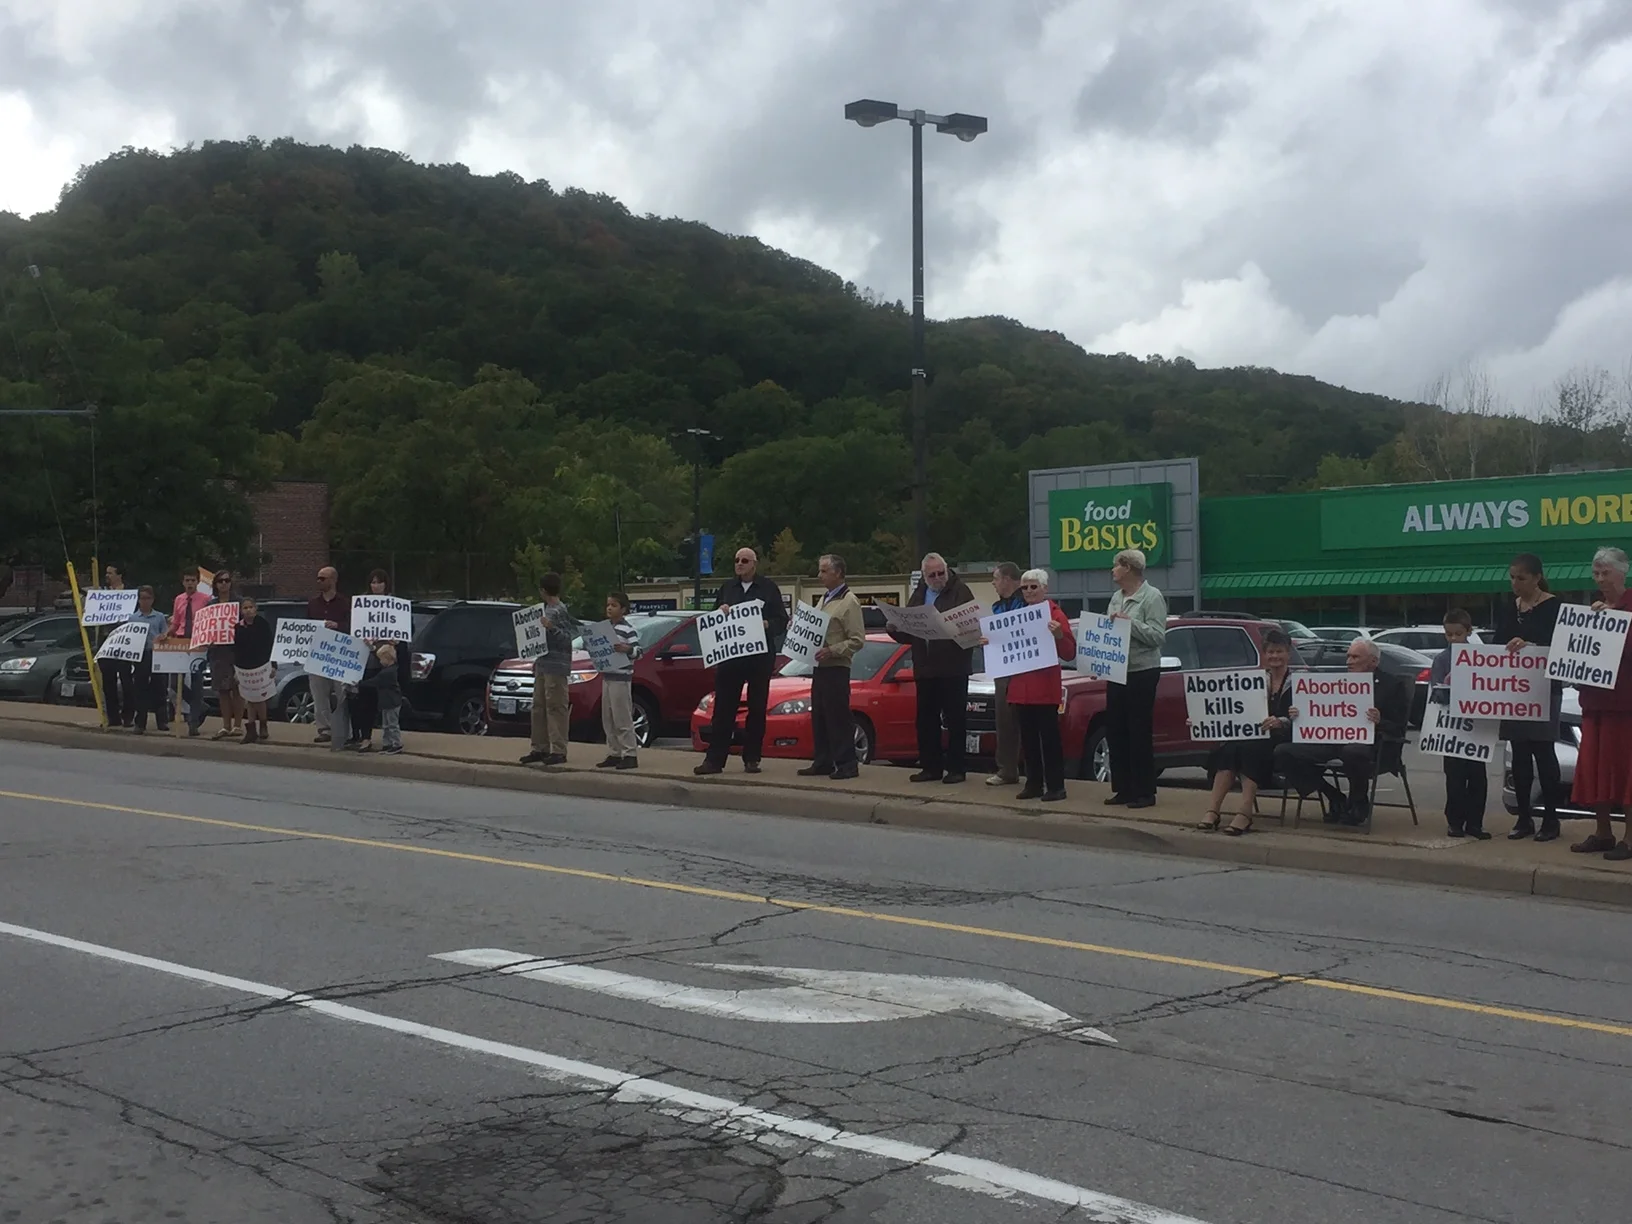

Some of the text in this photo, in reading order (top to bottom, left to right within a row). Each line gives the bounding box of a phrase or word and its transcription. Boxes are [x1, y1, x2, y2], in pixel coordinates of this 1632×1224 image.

[1084, 500, 1132, 522] food
[1402, 494, 1632, 533] ALWAYS MORE
[88, 592, 137, 601] Abortion
[353, 597, 411, 612] Abortion
[99, 603, 122, 611] kills
[196, 603, 239, 623] ABORTION
[944, 605, 980, 623] ABORTION
[194, 616, 237, 634] HURTS
[368, 611, 397, 624] kills
[698, 604, 761, 632] Abortion
[989, 609, 1043, 632] ADOPTION
[1098, 618, 1113, 630] Life
[1557, 606, 1628, 634] Abortion
[281, 621, 317, 634] Adoptio
[354, 627, 410, 640] children
[525, 625, 541, 640] kills
[714, 626, 746, 643] kills
[1010, 628, 1026, 639] THE
[276, 634, 313, 645] the lovi
[334, 633, 353, 645] Life
[1002, 637, 1038, 653] LOVING
[1085, 628, 1123, 648] the first
[1567, 633, 1601, 656] kills
[282, 647, 309, 659] optio
[320, 641, 360, 660] the first
[521, 642, 548, 659] childre
[706, 640, 765, 664] children
[1003, 649, 1040, 665] OPTION
[1078, 645, 1127, 665] inalienable
[1455, 649, 1547, 670] Abortion
[310, 649, 363, 671] inalienable
[321, 664, 346, 678] right
[1091, 661, 1112, 678] right
[1549, 660, 1613, 686] children
[1187, 674, 1264, 693] Abortion
[1296, 678, 1371, 695] Abortion
[1472, 672, 1531, 693] hurts
[1204, 697, 1244, 716] kills
[1309, 700, 1358, 718] hurts
[1458, 699, 1542, 717] women
[1299, 726, 1368, 740] women
[1420, 734, 1491, 760] children
